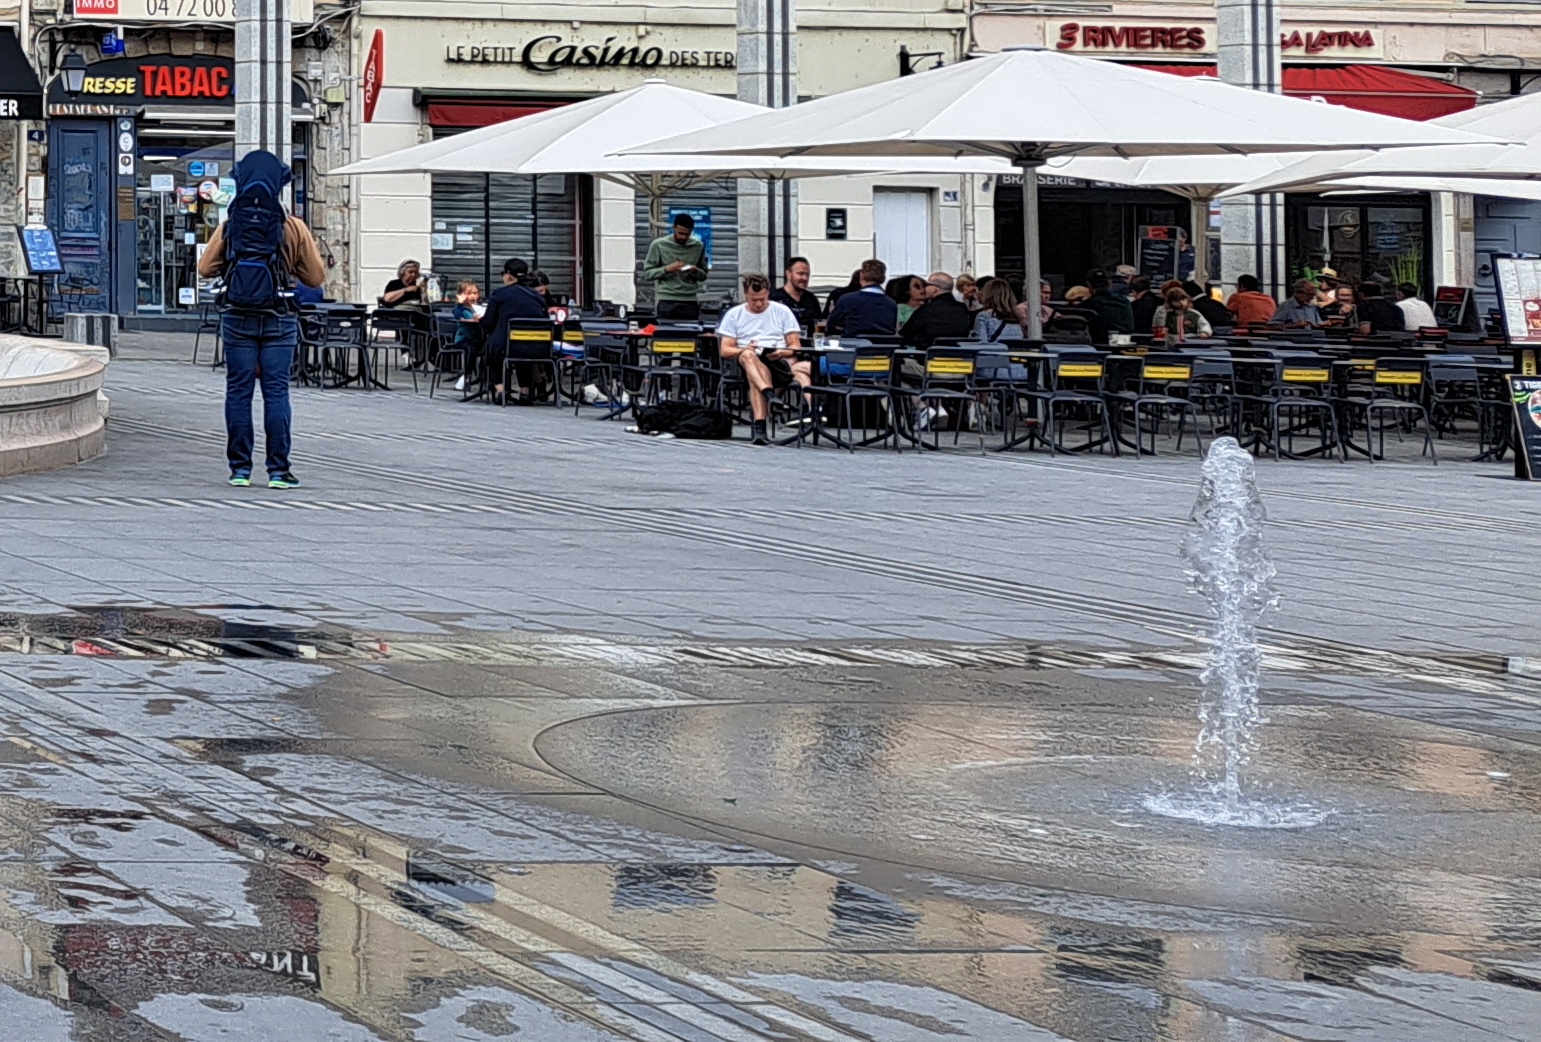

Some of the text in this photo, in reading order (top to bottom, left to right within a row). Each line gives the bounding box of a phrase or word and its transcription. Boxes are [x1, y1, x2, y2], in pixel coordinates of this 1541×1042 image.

[1056, 23, 1206, 51] 3 RIVIERES
[1305, 30, 1375, 54] LATINA
[446, 45, 463, 61] LE
[471, 47, 516, 62] PETIT
[521, 36, 664, 72] Casino
[669, 51, 700, 67] DES
[83, 65, 230, 98] RESSE TABAC
[365, 49, 377, 103] TABAC
